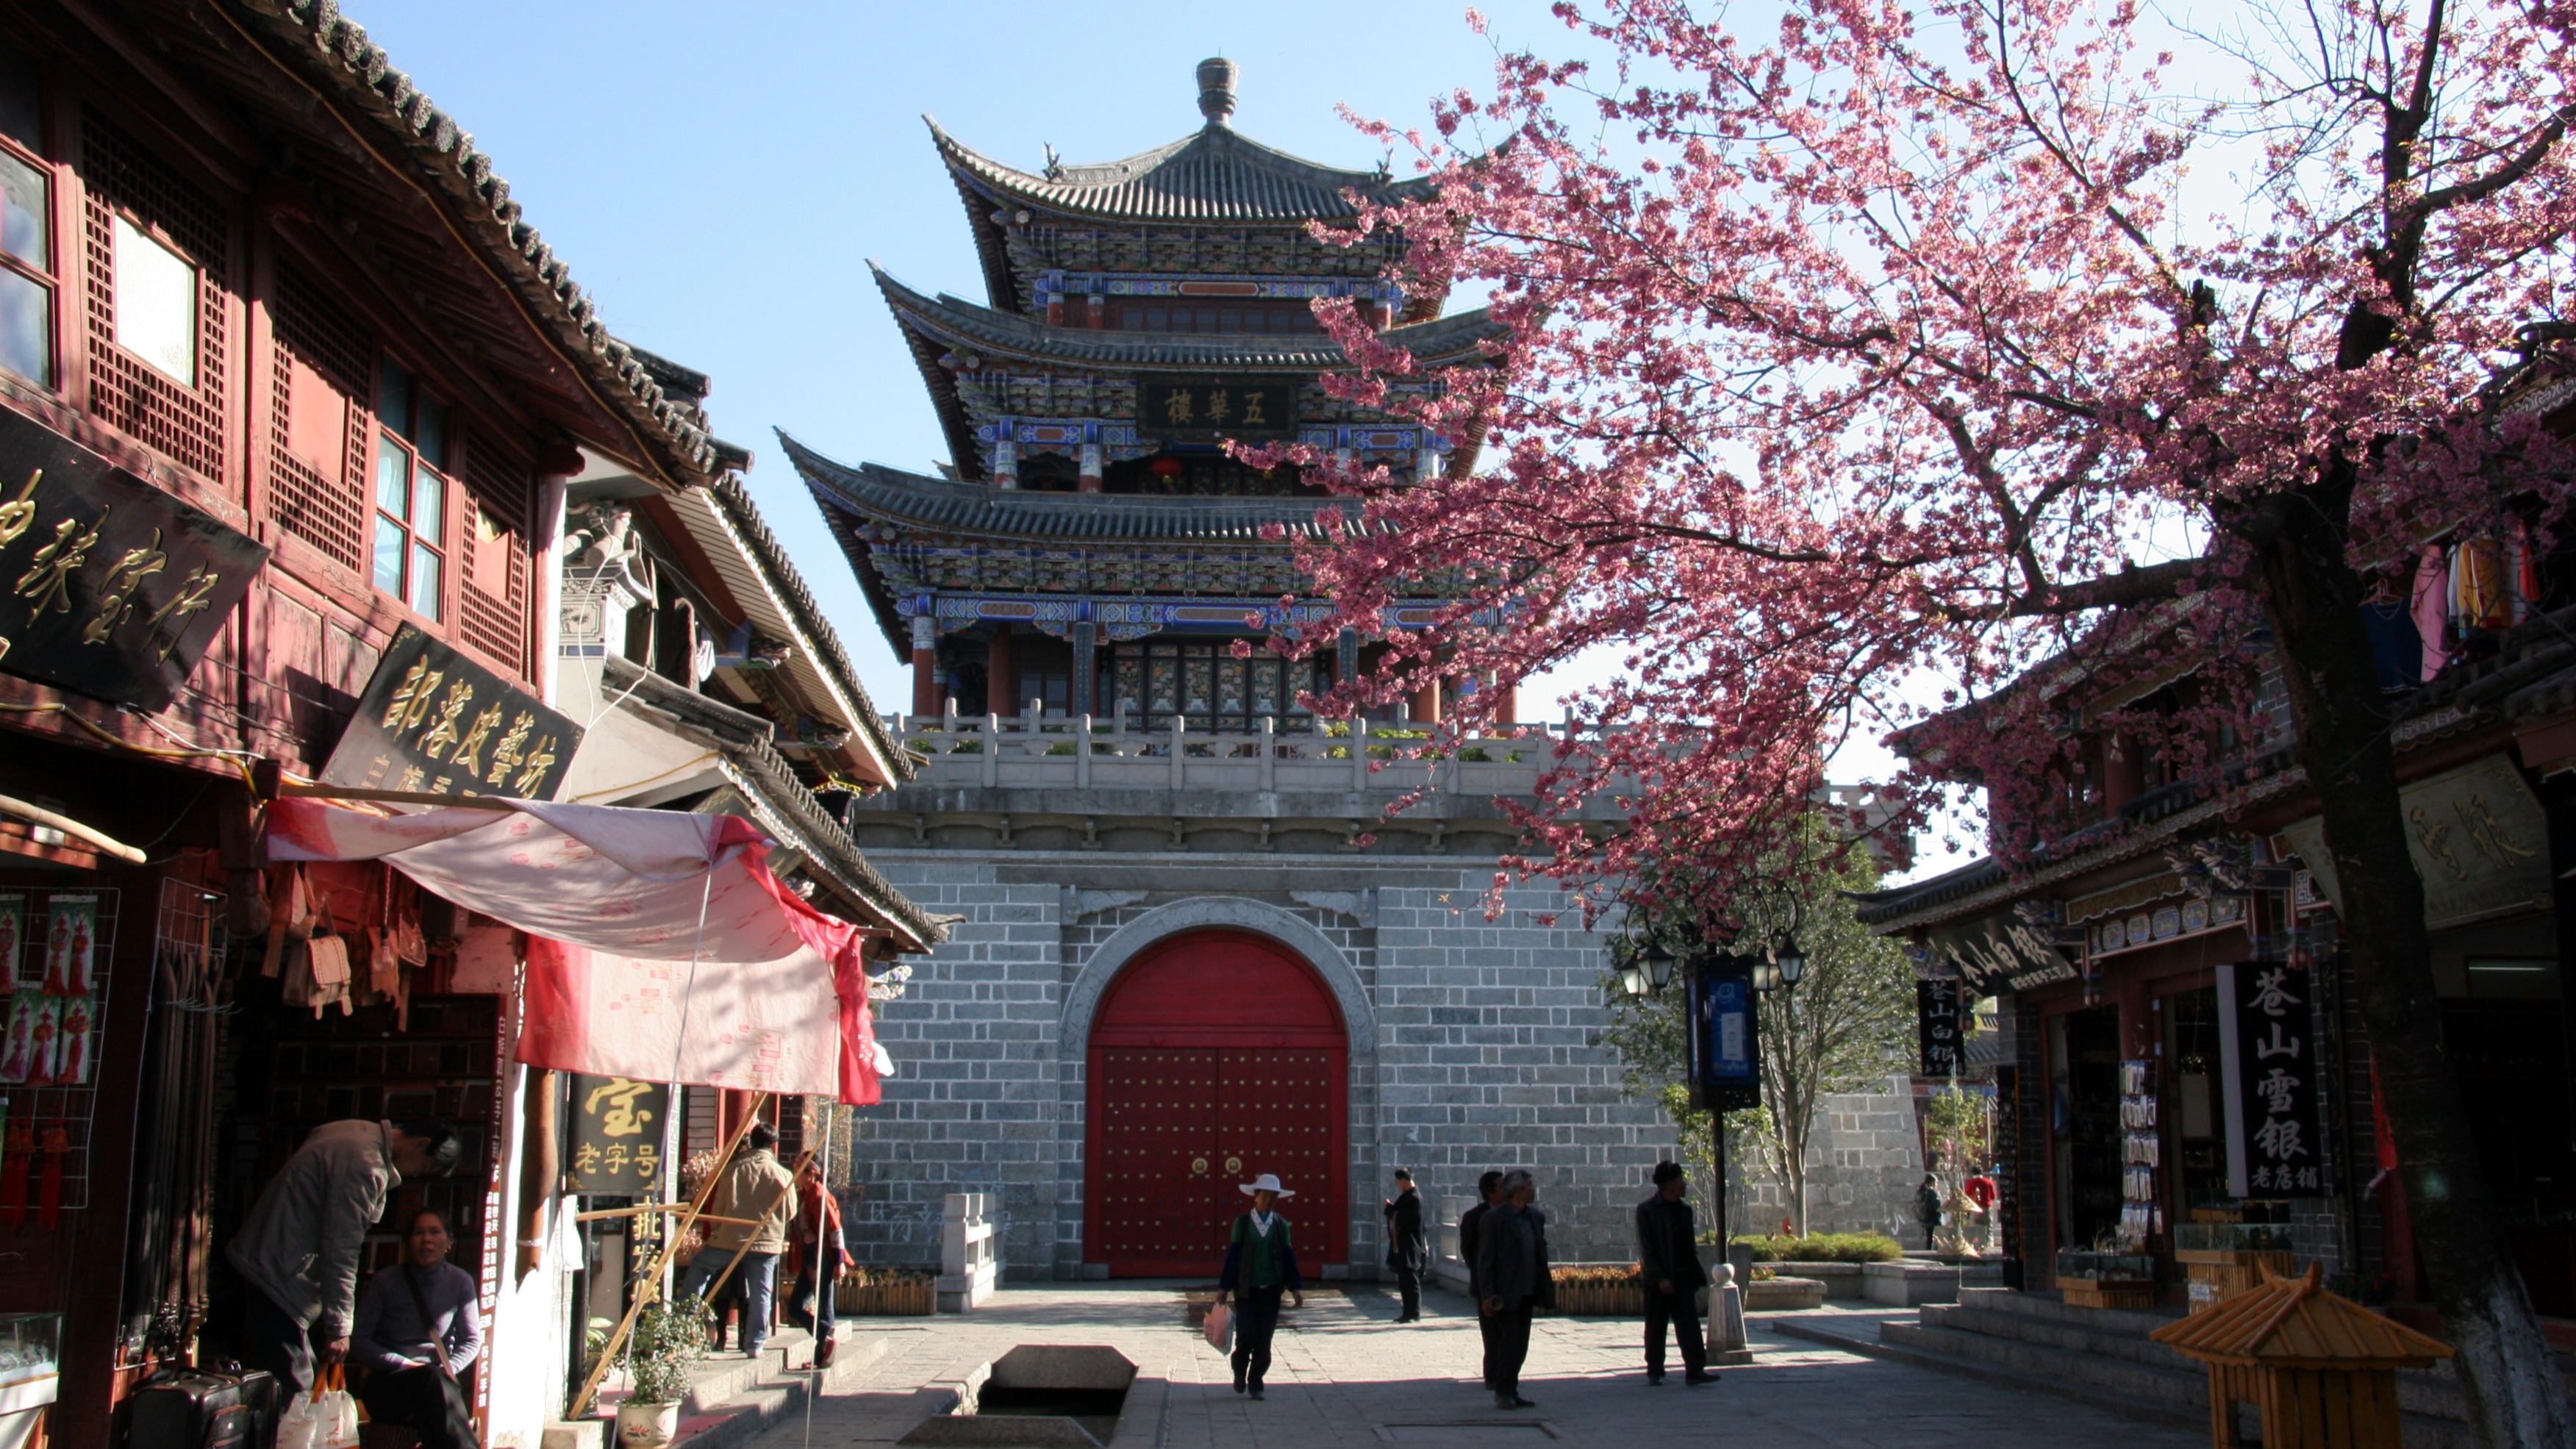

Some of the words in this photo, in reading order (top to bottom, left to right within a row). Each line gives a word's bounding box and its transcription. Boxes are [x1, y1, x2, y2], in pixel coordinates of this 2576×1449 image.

[1164, 388, 1265, 424] 五華樓
[382, 654, 557, 799] 部落皮藝坊
[2247, 967, 2308, 1160] 苍山雪银
[585, 1077, 653, 1137] 宝
[574, 1142, 659, 1177] 老字号
